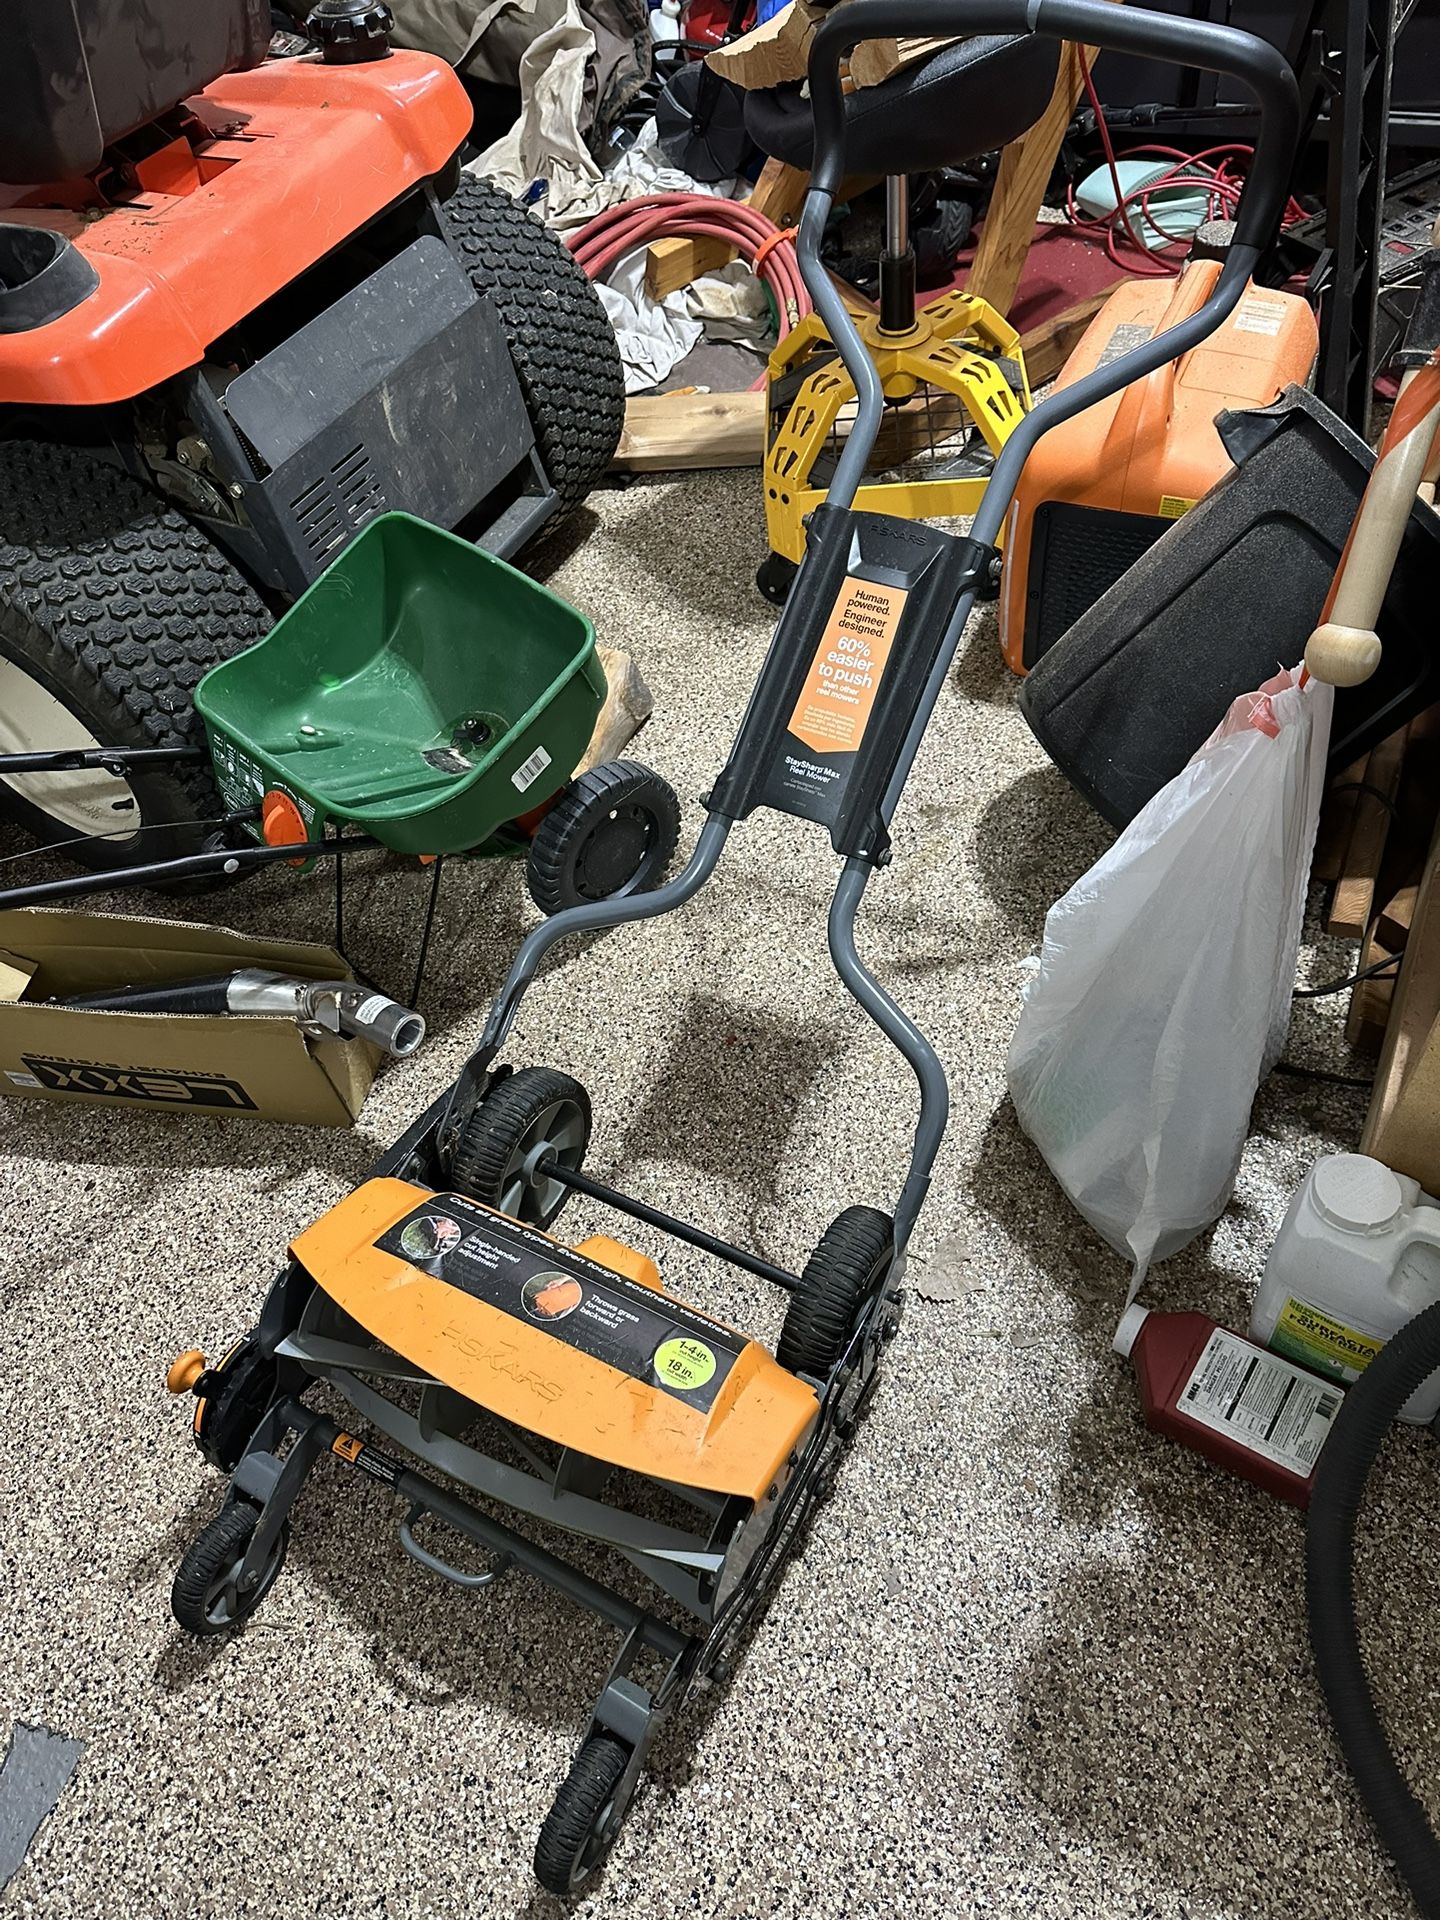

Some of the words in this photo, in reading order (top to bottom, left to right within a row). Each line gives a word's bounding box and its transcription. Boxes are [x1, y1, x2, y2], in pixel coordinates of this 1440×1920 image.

[846, 598, 890, 615] powered.
[854, 589, 889, 606] Human
[837, 619, 884, 638] designed.
[842, 608, 887, 627] Engineer
[836, 635, 871, 657] 60%
[826, 650, 874, 672] easier
[817, 661, 833, 677] to
[832, 668, 873, 688] push
[815, 687, 831, 696] reel
[830, 691, 859, 704] mowers
[822, 679, 838, 689] than
[839, 685, 859, 695] other
[788, 764, 806, 775] Reel
[805, 769, 830, 783] Mower
[822, 767, 840, 778] Max
[20, 1052, 120, 1070] SYSTEMS
[127, 1064, 226, 1079] EXHAUST
[38, 1064, 244, 1104] LEXX
[456, 1247, 499, 1270] adjustment
[462, 1241, 478, 1251] cut
[474, 1246, 500, 1264] height
[467, 1235, 521, 1264] Single-handed
[448, 1196, 476, 1211] Cuts
[473, 1207, 492, 1219] all
[488, 1216, 522, 1233] grass
[520, 1229, 556, 1249] types.
[558, 1248, 587, 1263] Even
[584, 1261, 623, 1283] tough,
[624, 1280, 672, 1305] southern
[679, 1308, 732, 1338] varieties.
[578, 1306, 619, 1329] backward
[583, 1300, 615, 1318] forward
[612, 1314, 625, 1323] or
[589, 1294, 619, 1312] Throws
[616, 1309, 640, 1324] grass
[1288, 1313, 1316, 1331] FOR
[1318, 1329, 1373, 1358] HERBIC
[1302, 1317, 1379, 1356] SURFACTA
[678, 1340, 697, 1354] 1-4
[695, 1349, 709, 1363] in.
[434, 1325, 565, 1404] FISKARS
[667, 1358, 683, 1371] 18
[680, 1366, 692, 1379] in.
[1206, 1374, 1218, 1393] DANGER
[1215, 1354, 1227, 1373] PELIGRO
